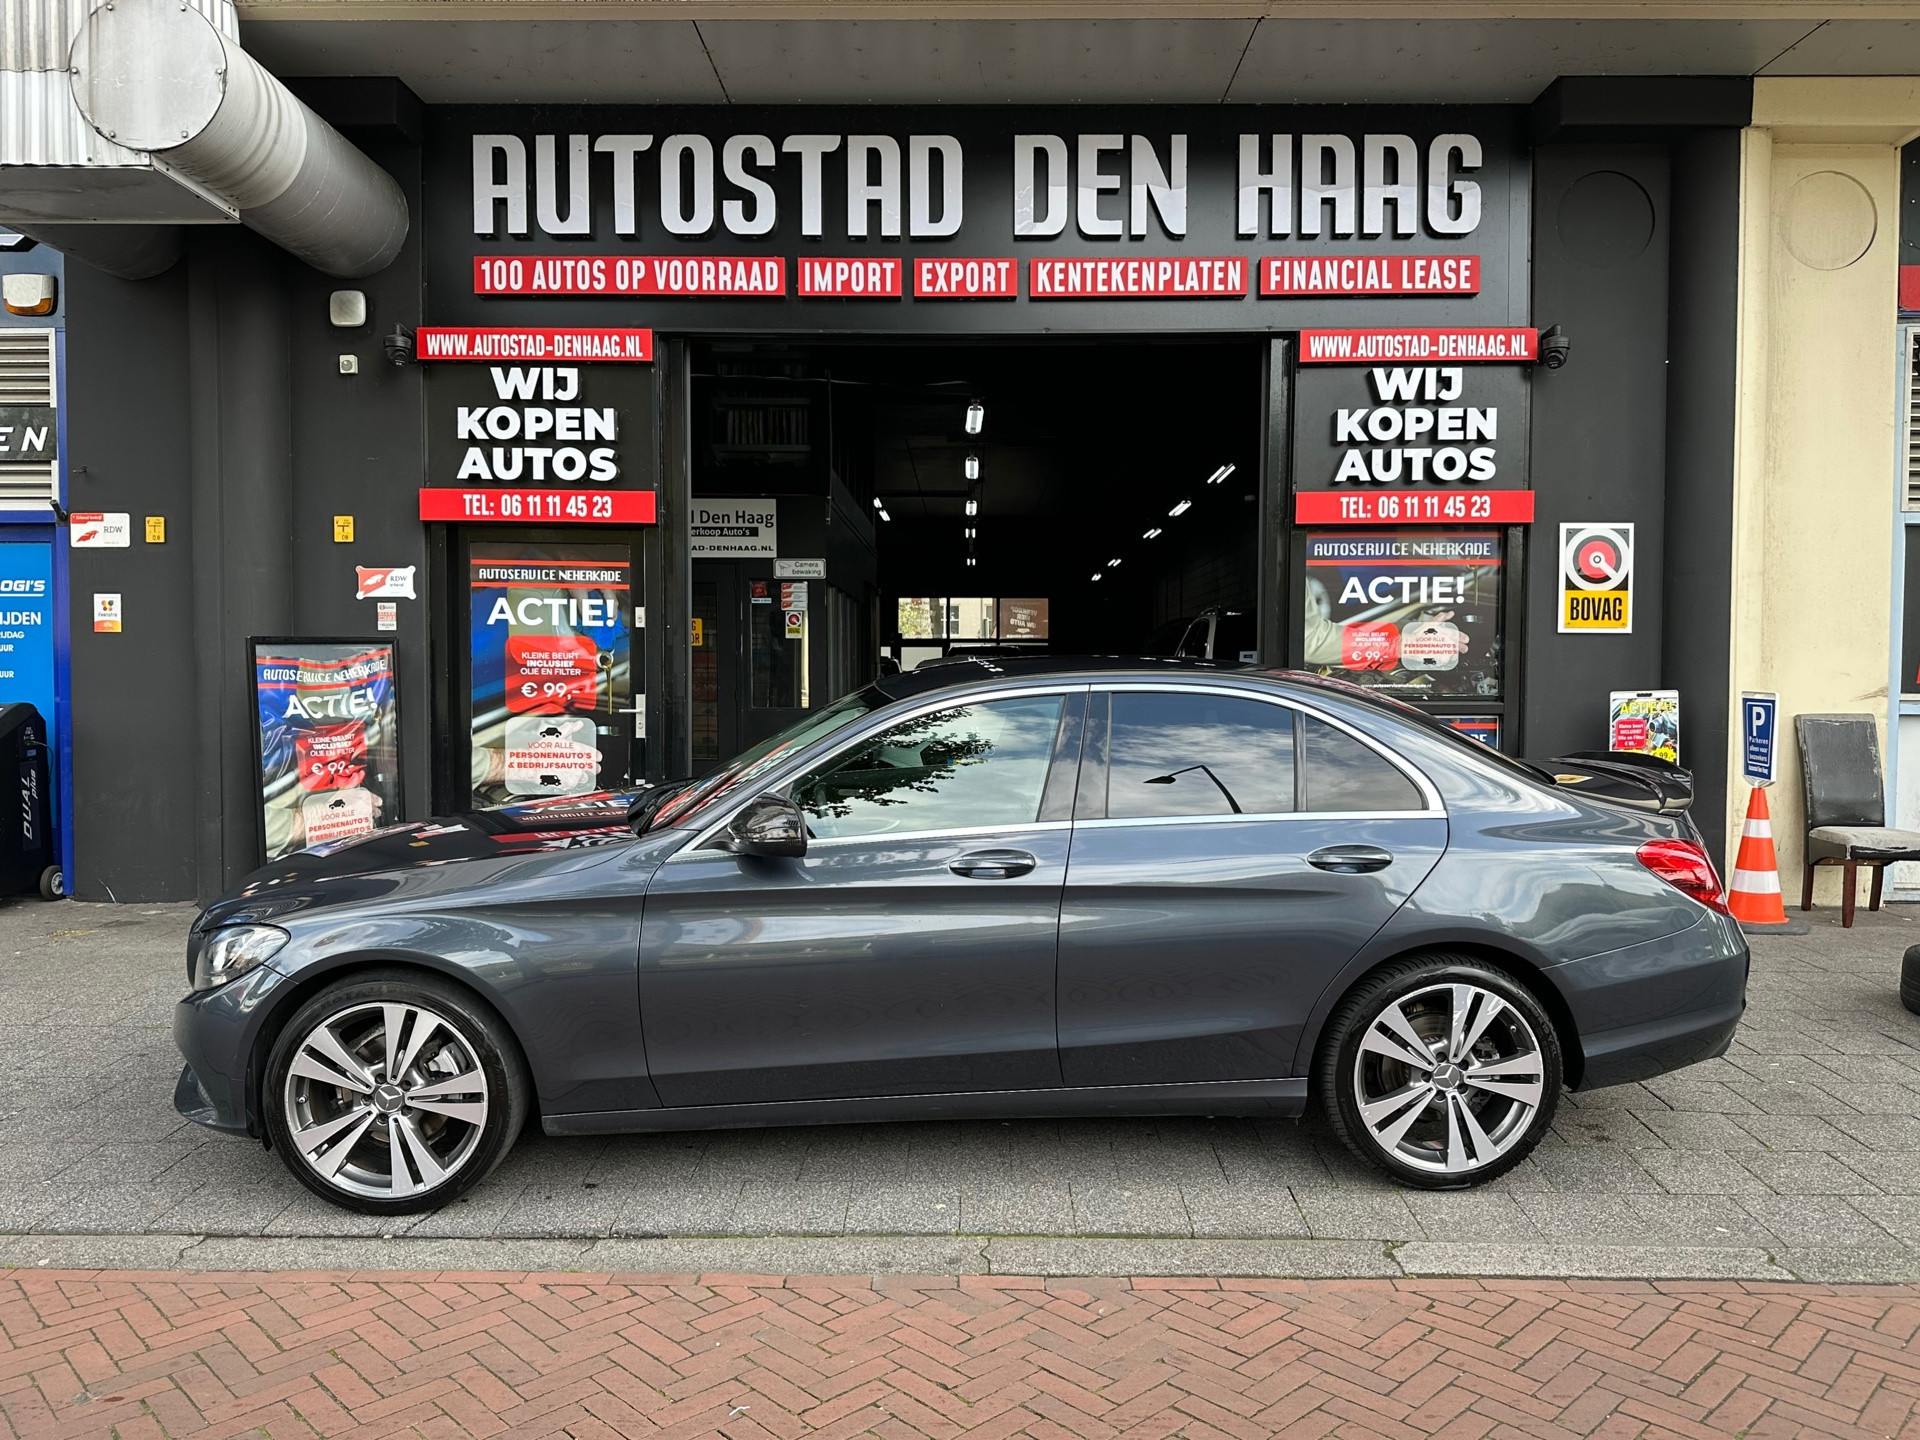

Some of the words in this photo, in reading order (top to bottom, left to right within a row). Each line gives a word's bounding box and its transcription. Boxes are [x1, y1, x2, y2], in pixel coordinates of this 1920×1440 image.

[473, 134, 963, 237] AUTOSTAD
[1014, 134, 1187, 236] DEN
[1238, 133, 1483, 236] HAAG
[481, 260, 524, 290] 100
[532, 260, 606, 291] AUTOS
[615, 261, 645, 291] OP
[653, 261, 779, 292] VOORRAAD
[804, 261, 895, 292] IMPORT
[921, 261, 1009, 292] EXPORT
[1037, 260, 1242, 292] KENTEKENPLATEN
[1269, 259, 1393, 291] FINANCIAL
[1402, 258, 1471, 289] LEASE
[426, 334, 643, 357] WWW.AUTOSTAD-DENHAAG.NL
[1310, 334, 1528, 357] WWW.AUTOSTAD-DENHAAG.NL
[490, 367, 579, 401] WIJ
[1372, 367, 1463, 401] WIJ
[457, 406, 615, 441] KOPEN
[1336, 407, 1498, 442] KOPEN
[456, 447, 618, 482] AUTOS
[1334, 447, 1497, 482] AUTOS
[463, 494, 495, 516] TEL:
[501, 495, 522, 516] 06
[527, 495, 541, 517] 11
[547, 495, 561, 517] 11
[566, 496, 587, 517] 45
[593, 496, 613, 518] 23
[1340, 496, 1372, 518] TEL:
[1378, 496, 1399, 517] 06
[1404, 496, 1419, 517] 11
[1424, 496, 1439, 517] 11
[1444, 496, 1466, 517] 45
[1471, 495, 1491, 517] 23
[103, 526, 123, 534] RDW
[699, 510, 731, 524] Den
[735, 510, 774, 528] Haag
[722, 527, 750, 536] Auto's
[1314, 542, 1409, 556] AUTOSERVICE
[1412, 542, 1491, 556] NEHERKADE
[479, 568, 556, 581] AUTOSERVICE
[558, 569, 622, 582] NEHERKADE
[1338, 576, 1466, 604] ACTIE!
[486, 597, 616, 628] ACTIE!
[1570, 597, 1623, 621] BOVAG
[1351, 651, 1363, 661] €
[1365, 651, 1390, 662] 99,-
[263, 667, 332, 683] AUTOSERVICE
[334, 659, 386, 682] NEHERKADE
[554, 668, 581, 676] FILTER
[282, 687, 378, 719] ACTIE!
[521, 682, 538, 698] €
[543, 682, 581, 700] 99,-
[1752, 706, 1766, 736] P
[528, 741, 553, 749] VOOR
[311, 762, 325, 776] €
[327, 761, 355, 775] 99,-
[30, 768, 39, 800] plus
[21, 776, 33, 840] DUAL
[321, 812, 340, 821] VOOR
[341, 810, 355, 818] ALLE
[308, 817, 369, 832] PERSONENAUTO'S
[315, 825, 372, 841] BEDRIJFSAUTO'S
